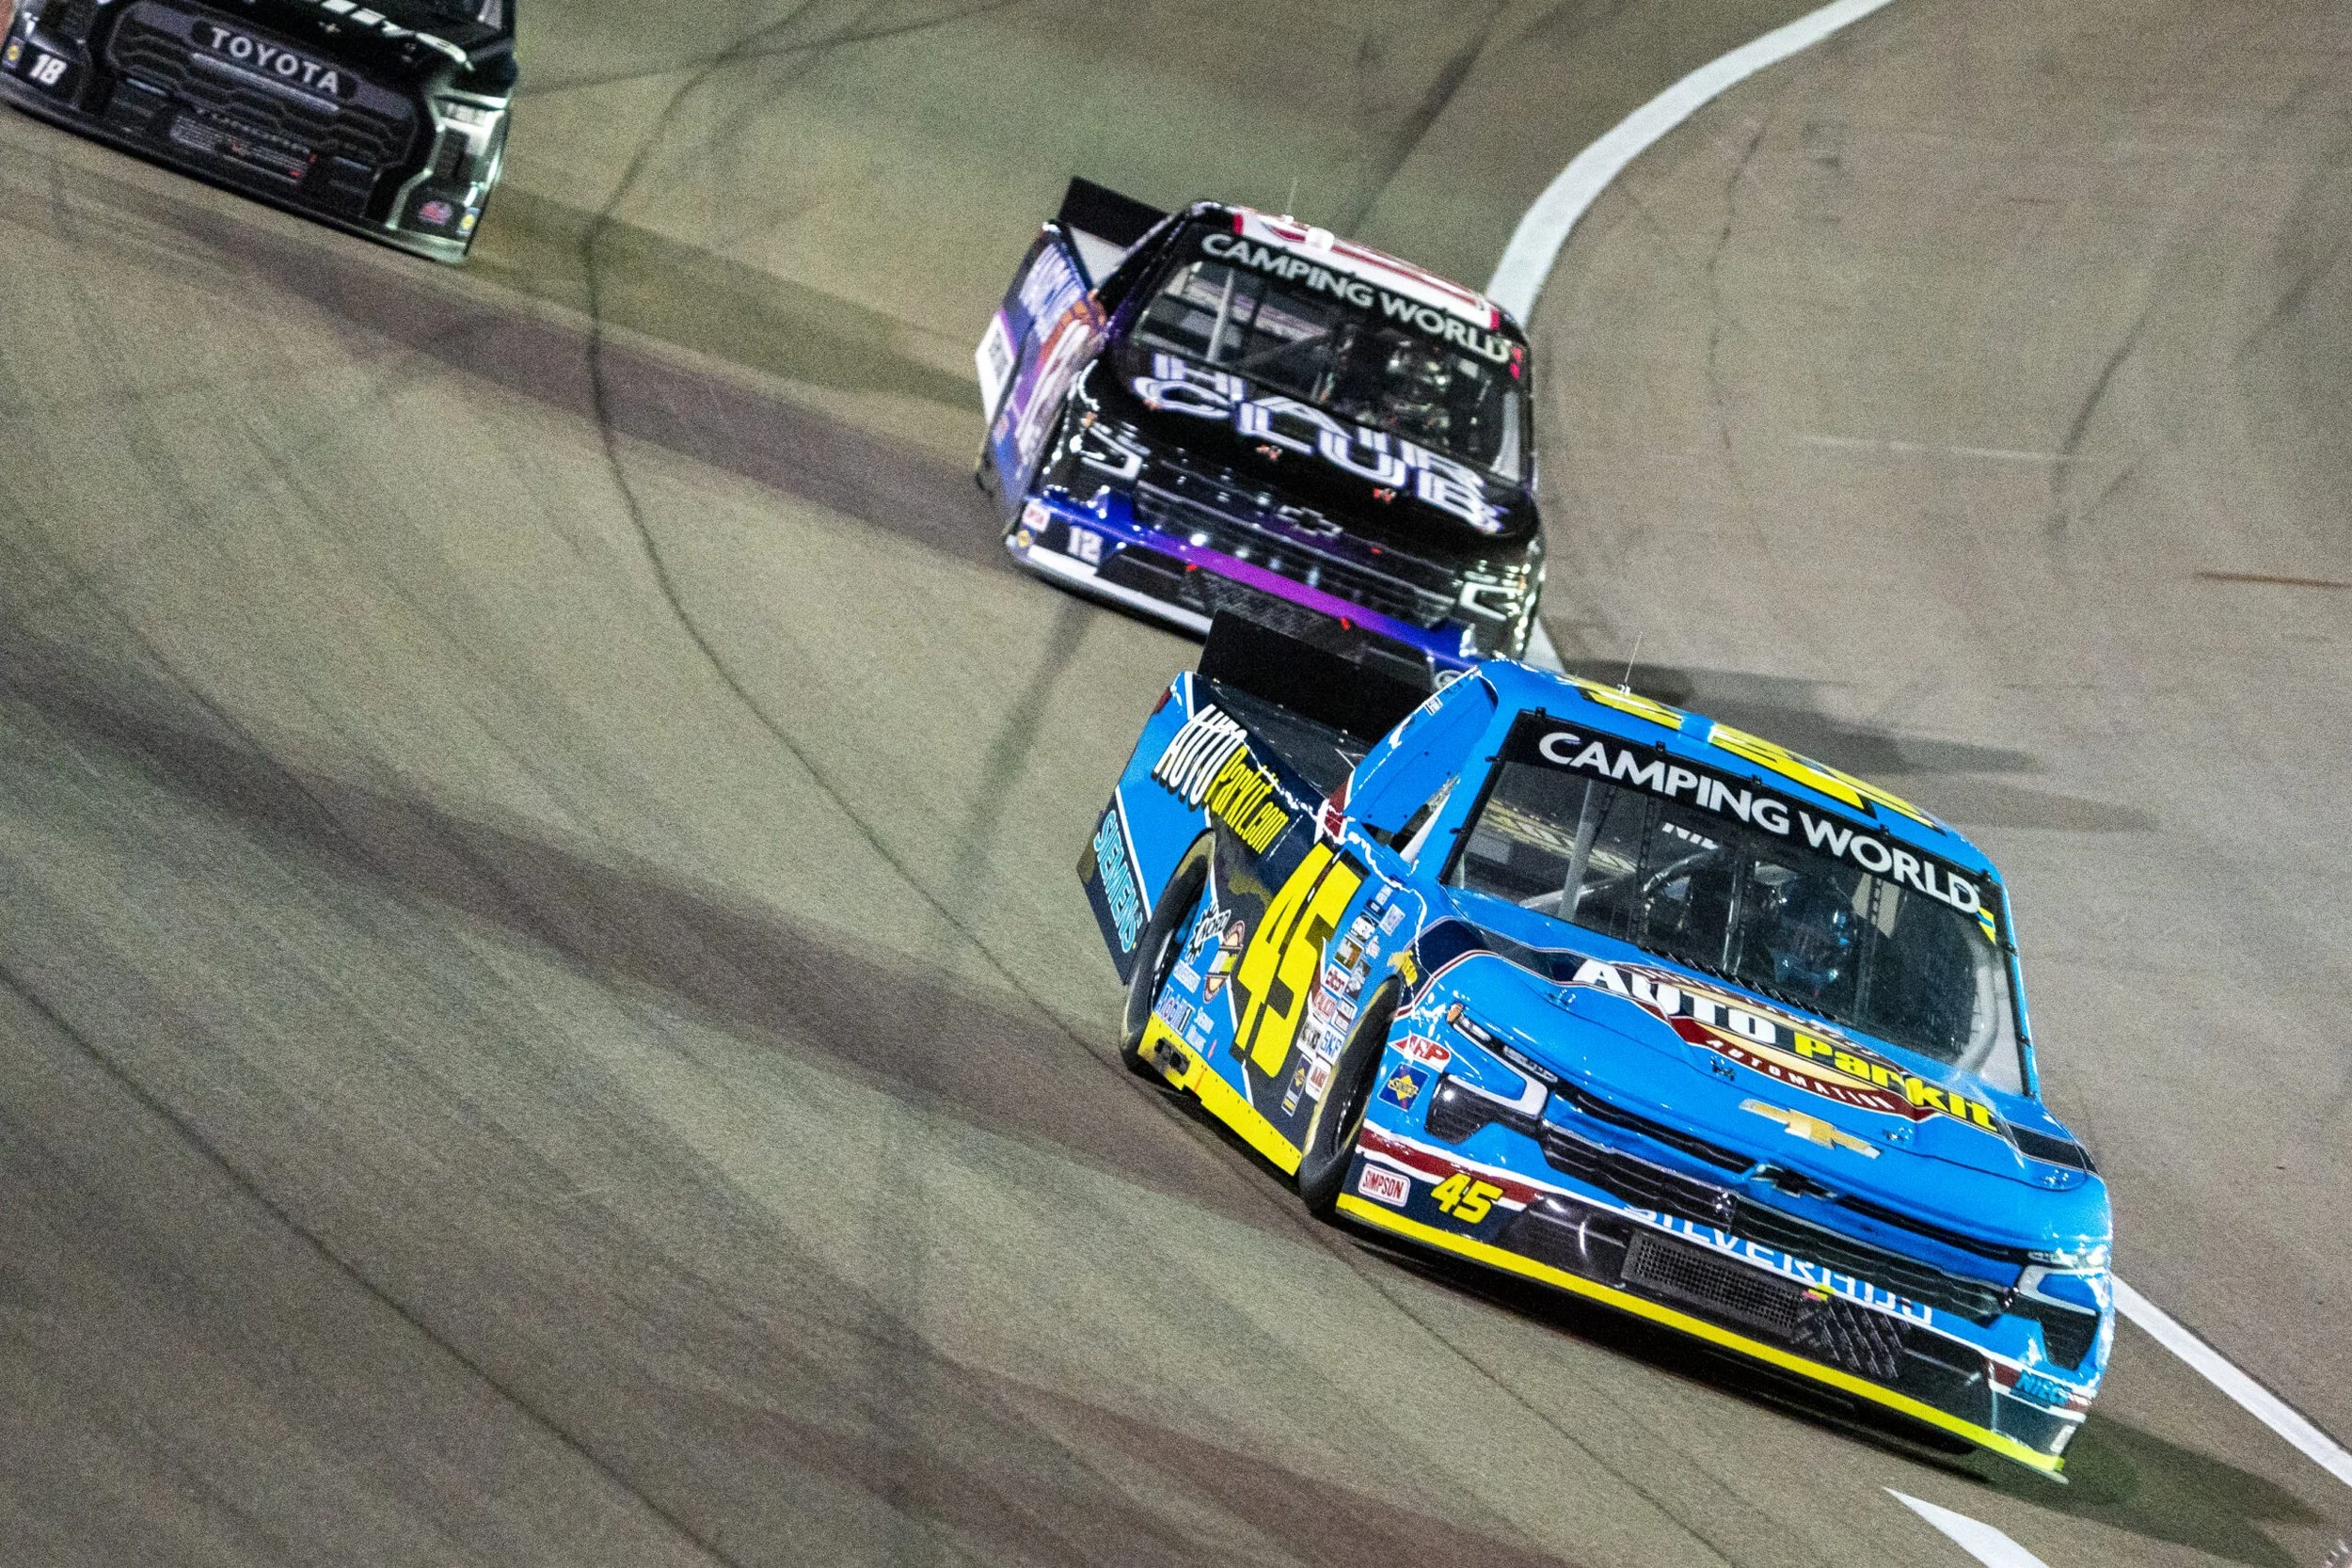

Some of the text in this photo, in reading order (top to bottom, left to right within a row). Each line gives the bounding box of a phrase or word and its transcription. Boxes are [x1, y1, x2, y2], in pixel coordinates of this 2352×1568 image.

[30, 54, 68, 85] 18
[210, 26, 340, 95] TOYOTA
[1201, 234, 1510, 363] CAMPING WORLD
[1134, 376, 1507, 533] CLUB
[1068, 526, 1104, 565] 12
[1538, 732, 1980, 913] CAMPING WORLD
[1093, 810, 1143, 953] SIEMENS
[1235, 842, 1362, 1078] 45
[1320, 1031, 1343, 1058] SKF
[1707, 1038, 1896, 1111] AUTOMATION
[1362, 1169, 1405, 1200] SIMPSON
[1430, 1172, 1504, 1224] 45
